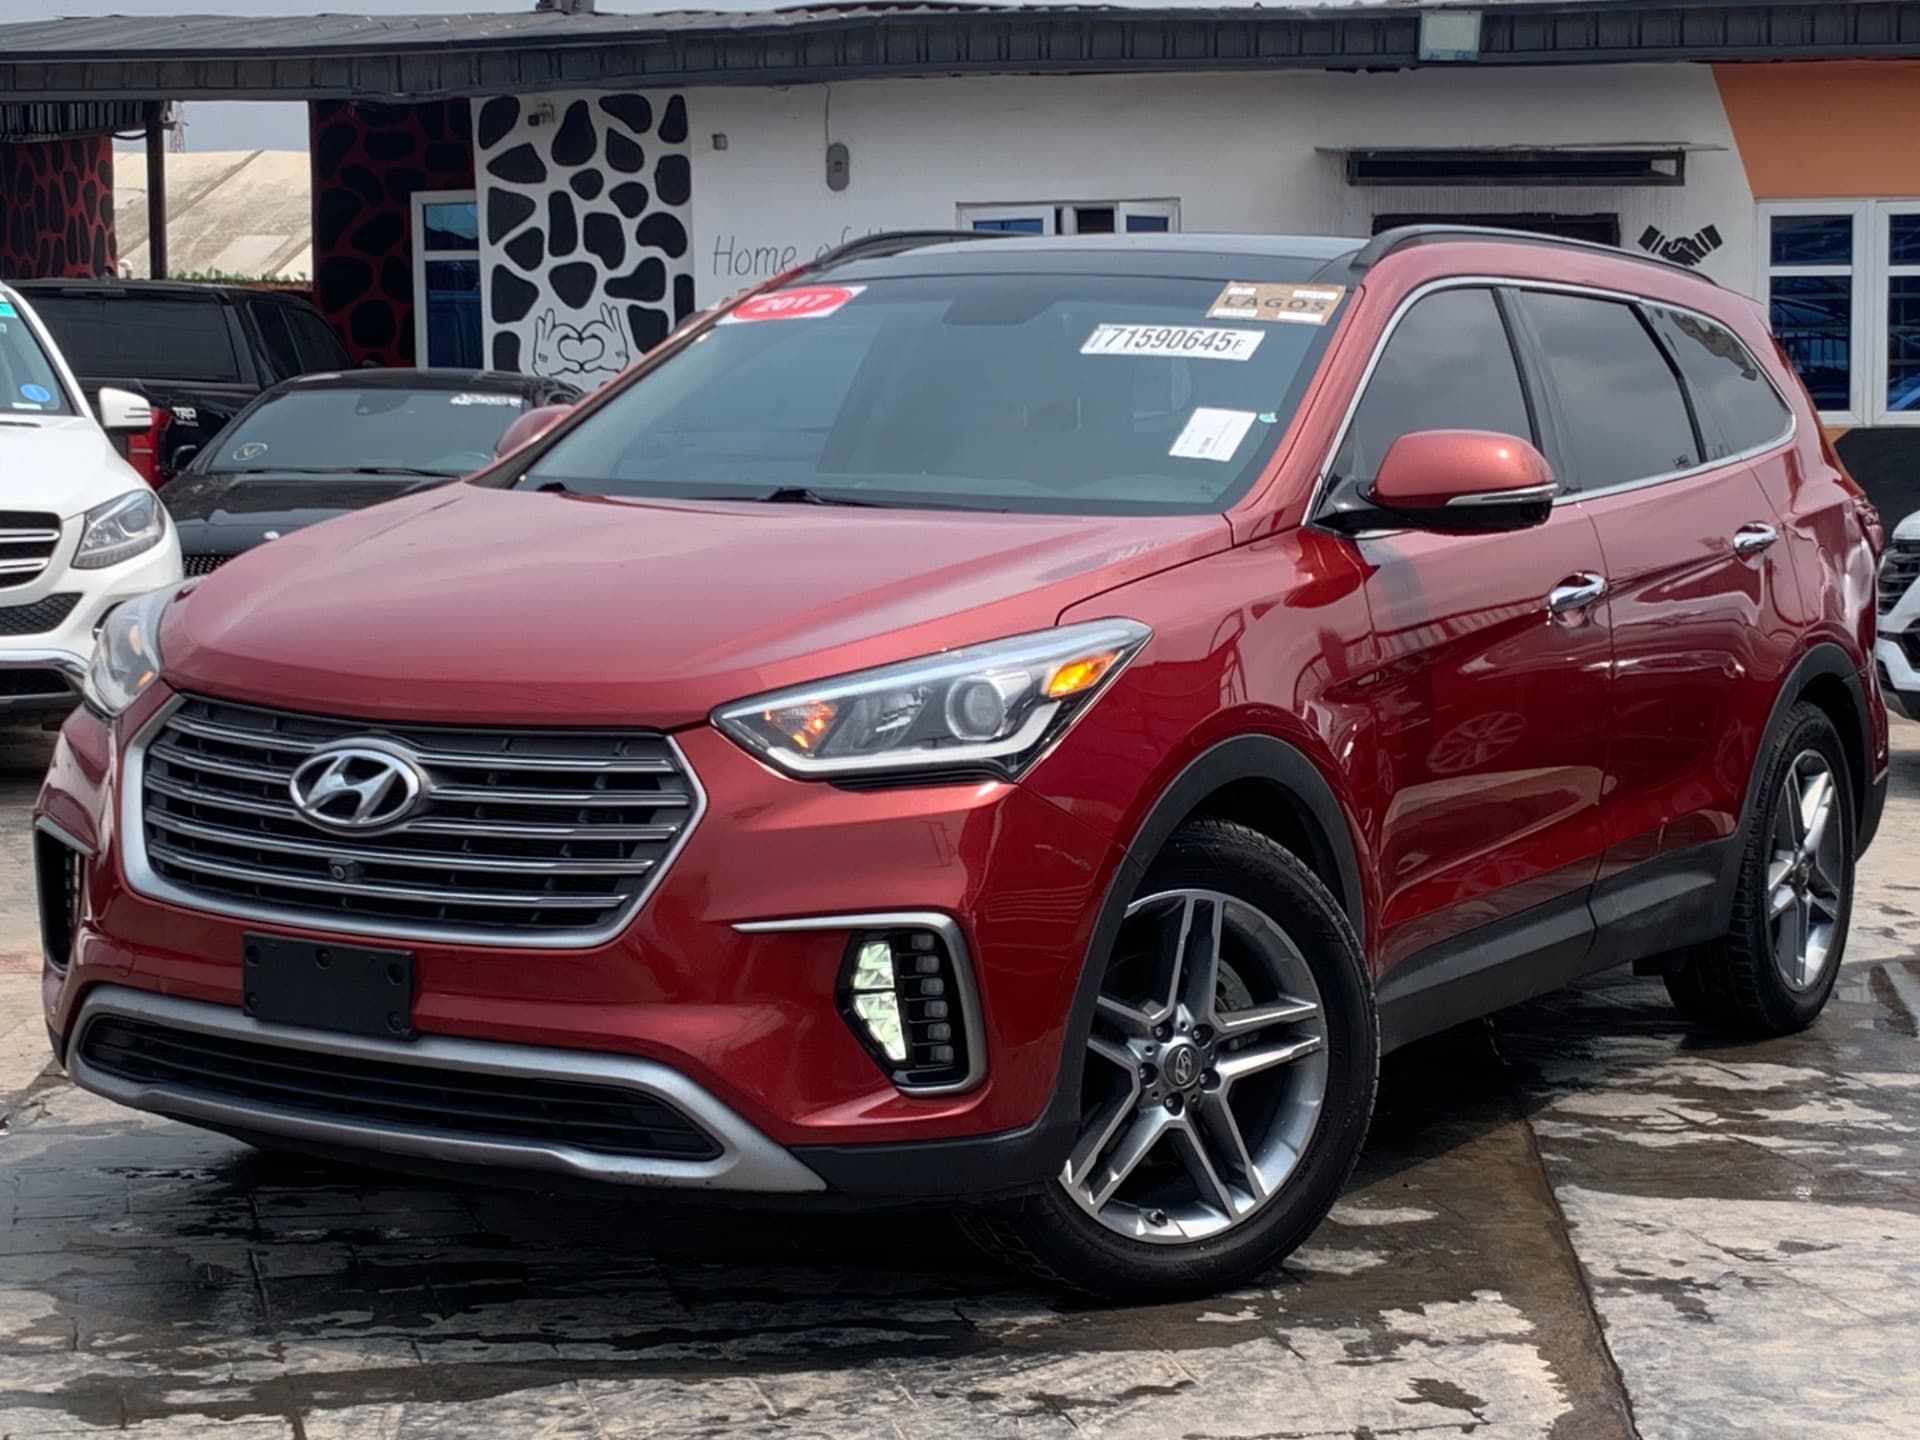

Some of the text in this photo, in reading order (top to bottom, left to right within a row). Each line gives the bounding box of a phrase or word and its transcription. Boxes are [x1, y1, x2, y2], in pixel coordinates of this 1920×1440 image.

[712, 235, 798, 276] Home
[751, 294, 834, 313] 2017
[1223, 296, 1329, 312] LAGOS
